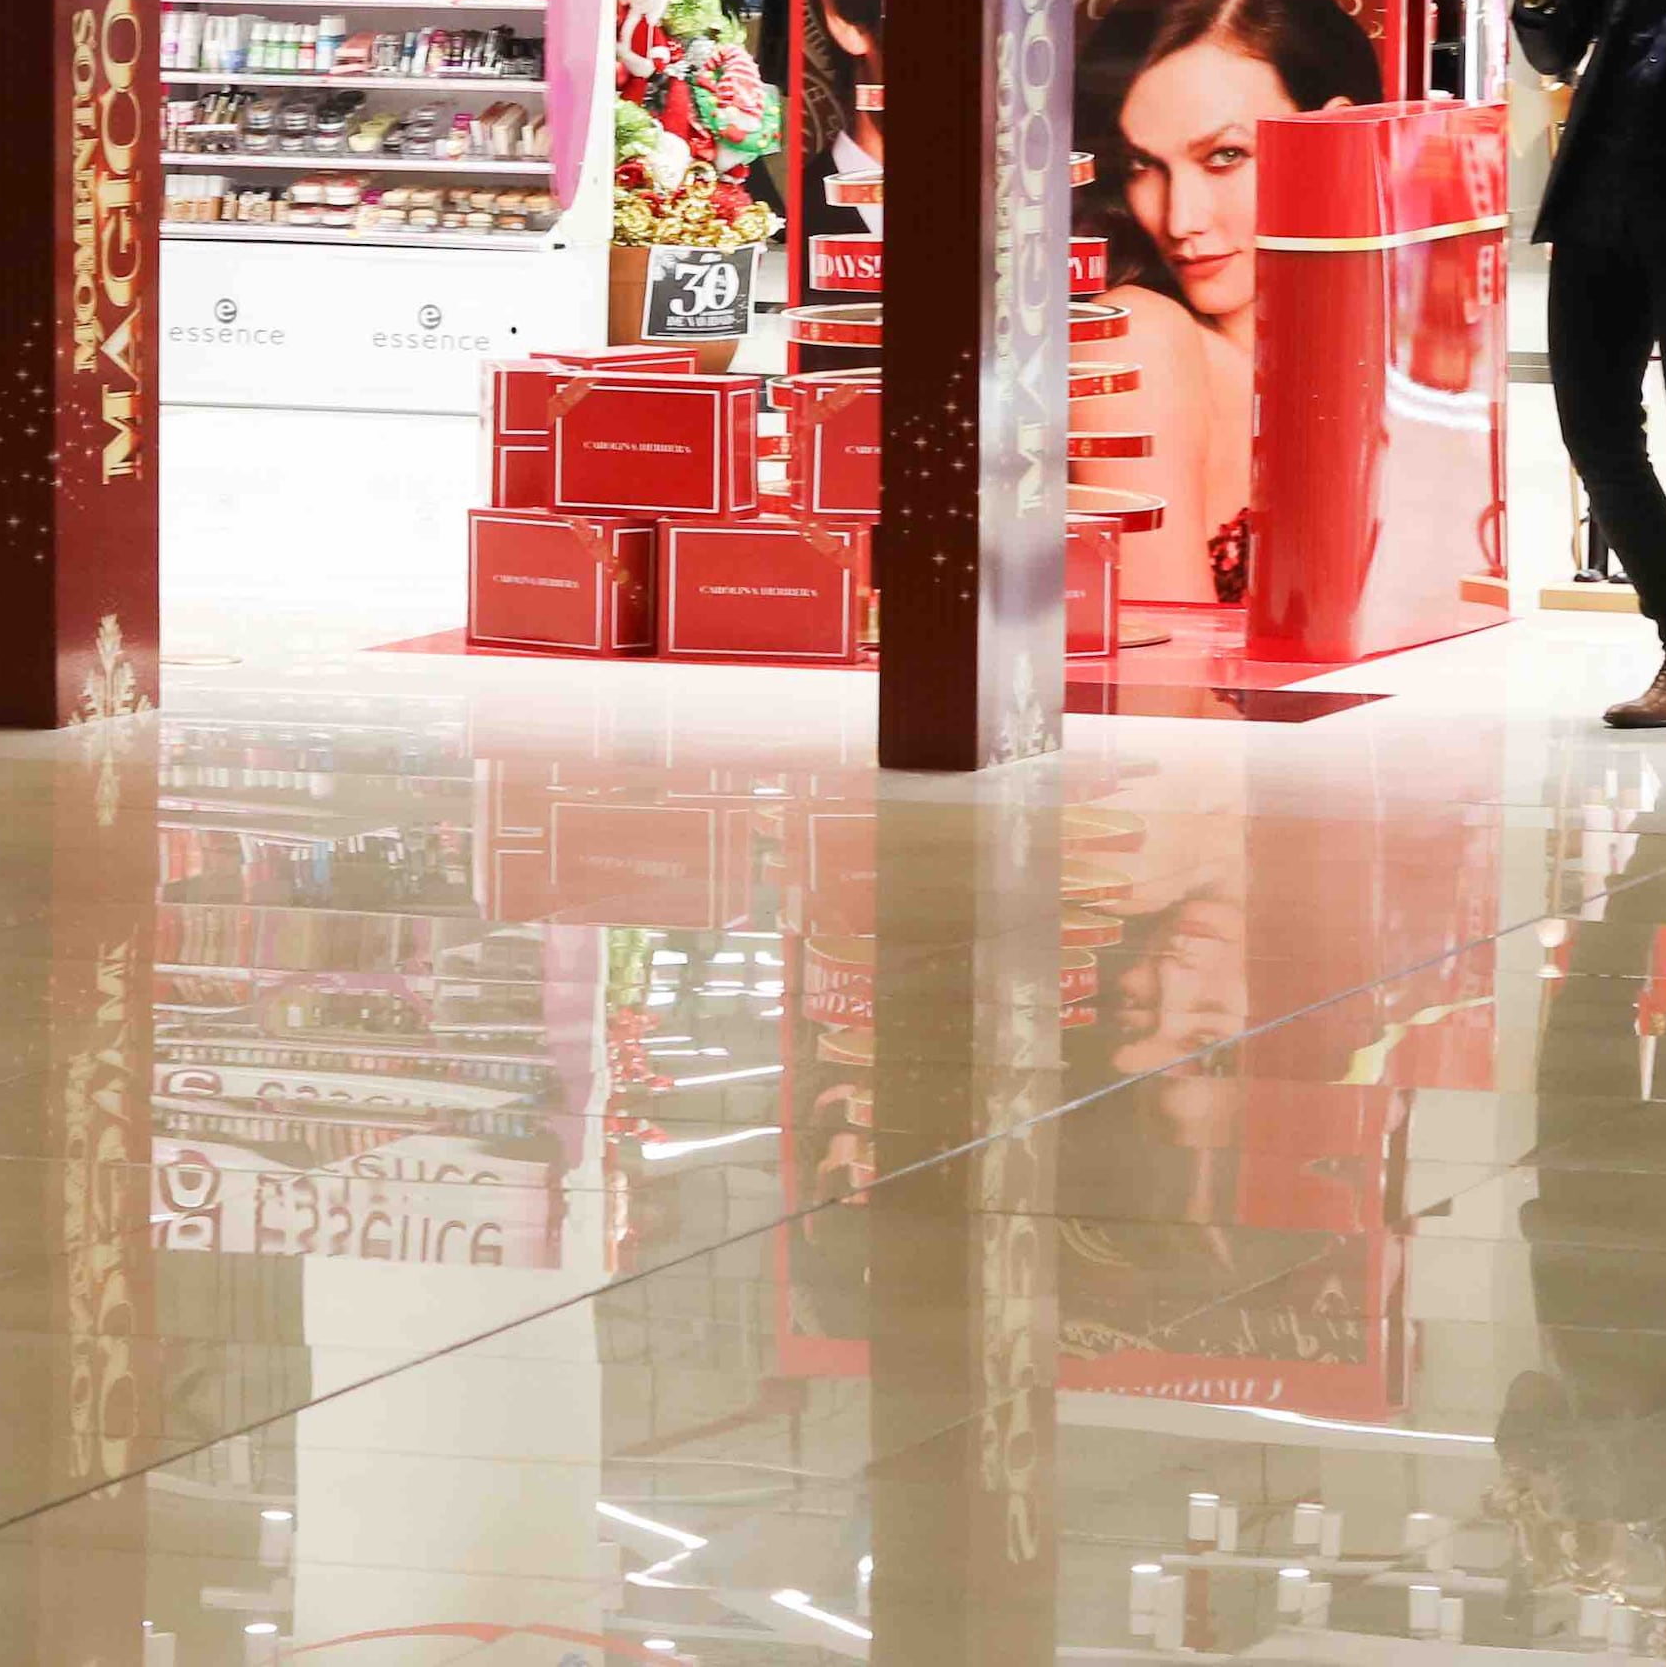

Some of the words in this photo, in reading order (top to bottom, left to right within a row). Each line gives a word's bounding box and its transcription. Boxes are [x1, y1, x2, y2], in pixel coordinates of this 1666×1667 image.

[72, 8, 98, 375] MOMENTOS
[169, 324, 286, 346] essence
[372, 331, 491, 352] essence
